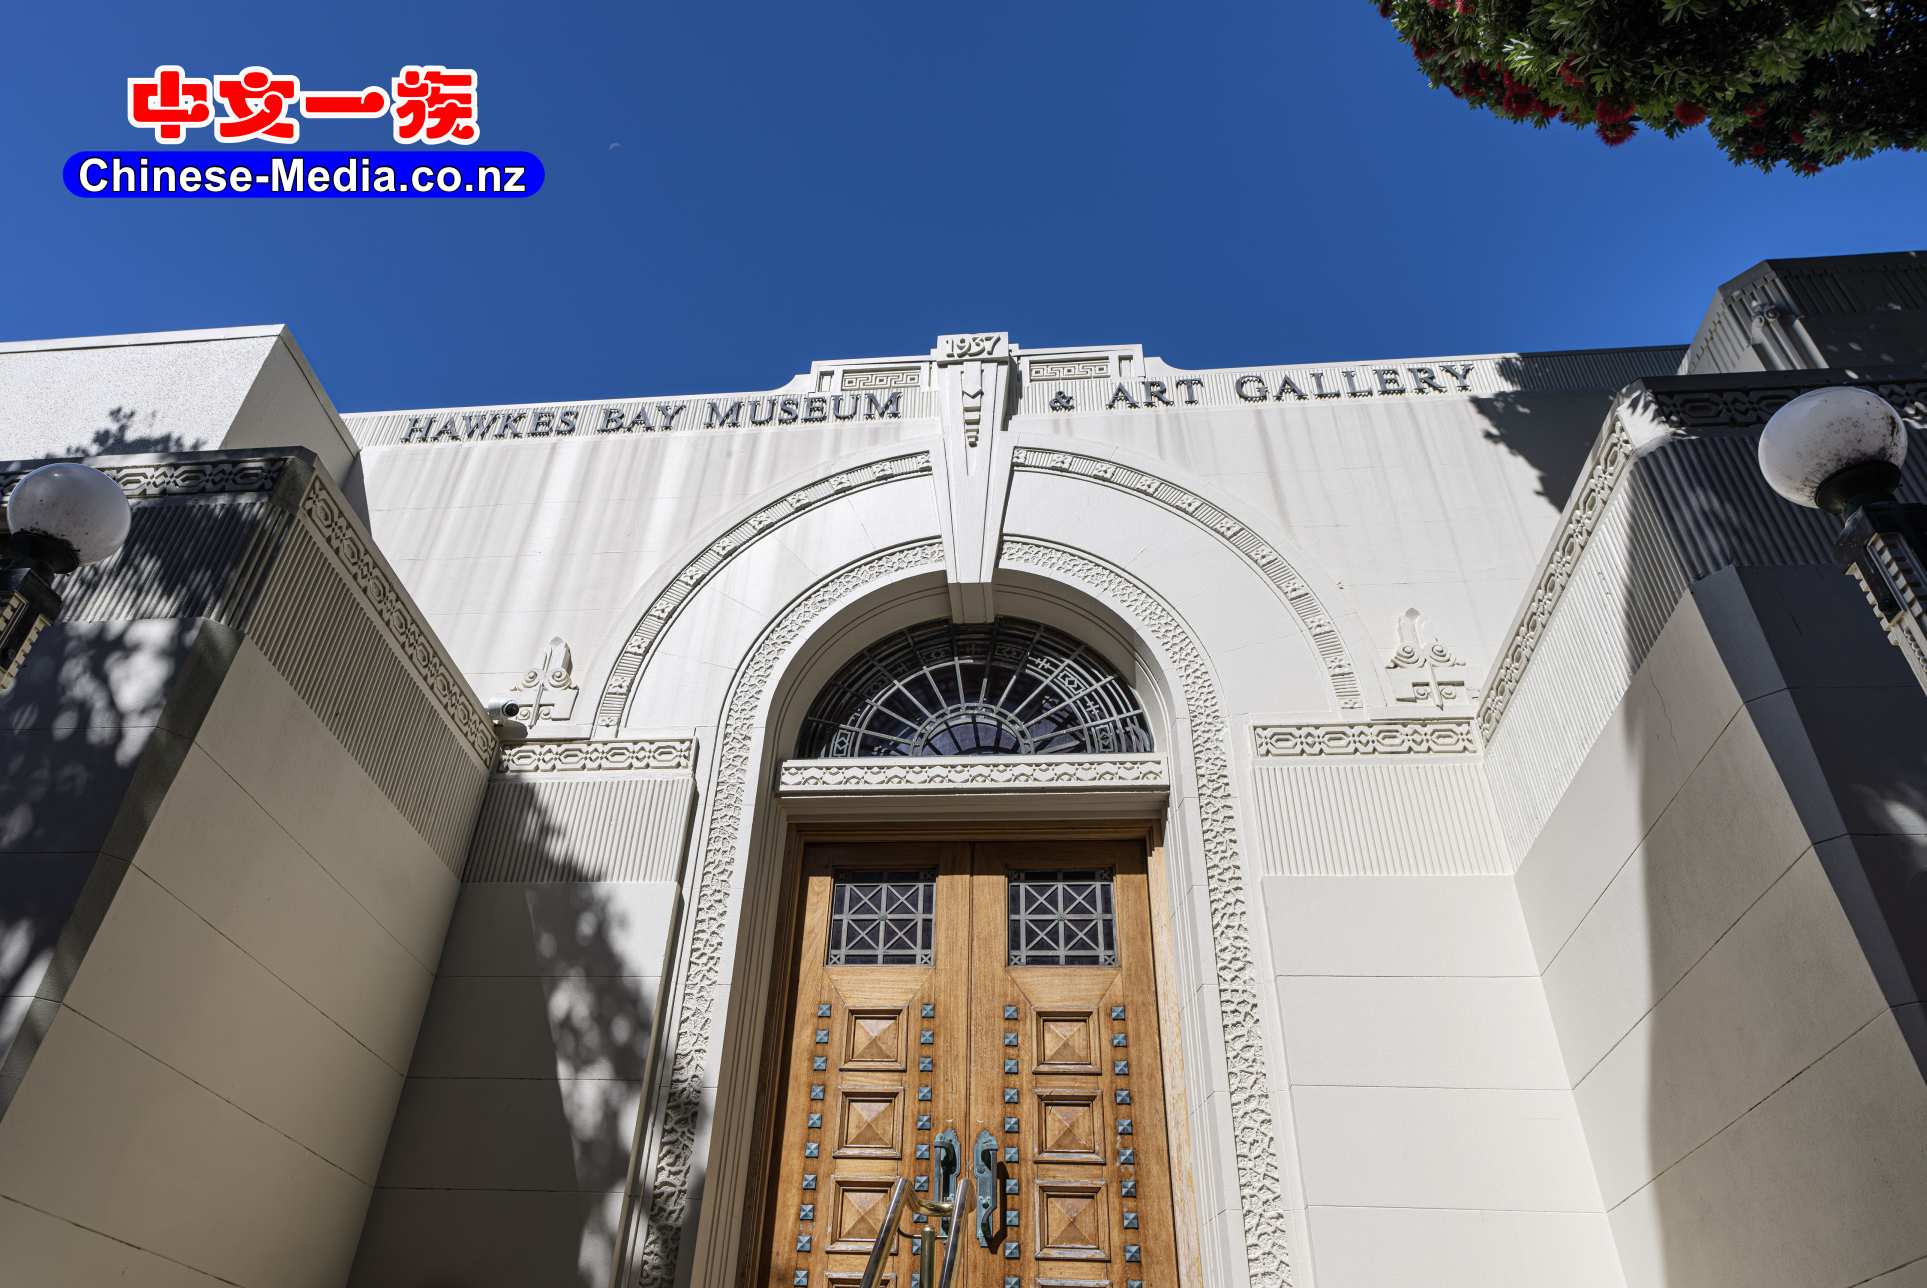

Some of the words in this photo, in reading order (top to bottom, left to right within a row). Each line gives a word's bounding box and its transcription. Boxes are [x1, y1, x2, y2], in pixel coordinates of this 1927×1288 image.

[944, 335, 1001, 358] 1937
[401, 409, 579, 443] HAWKES
[597, 404, 686, 433] BAY
[704, 391, 903, 429] MUSEUM
[1050, 390, 1075, 412] &
[1105, 378, 1204, 409] ART
[1235, 363, 1474, 403] GALLERY
